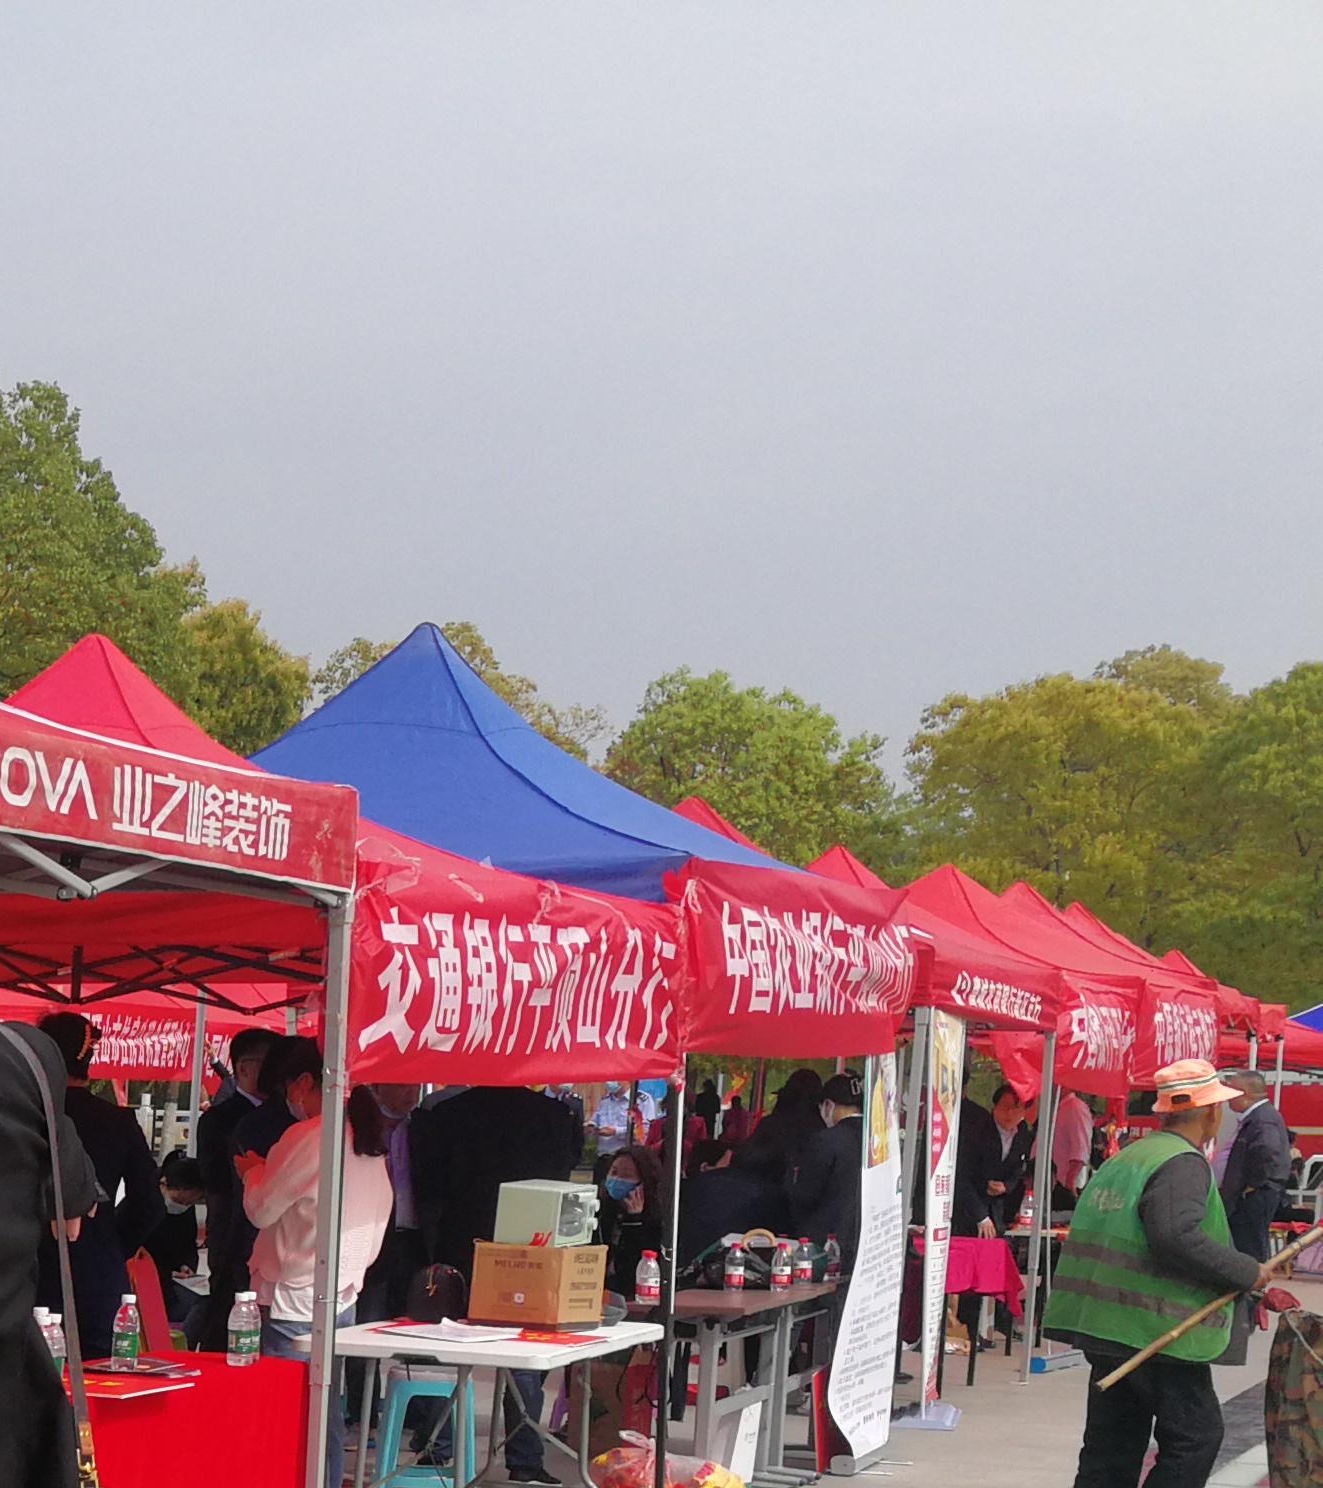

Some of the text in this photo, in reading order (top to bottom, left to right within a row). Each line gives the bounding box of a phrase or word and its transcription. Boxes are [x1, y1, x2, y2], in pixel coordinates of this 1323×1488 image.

[111, 763, 290, 862] 业之峰装饰
[358, 906, 677, 1057] 交通银行平顶山分行
